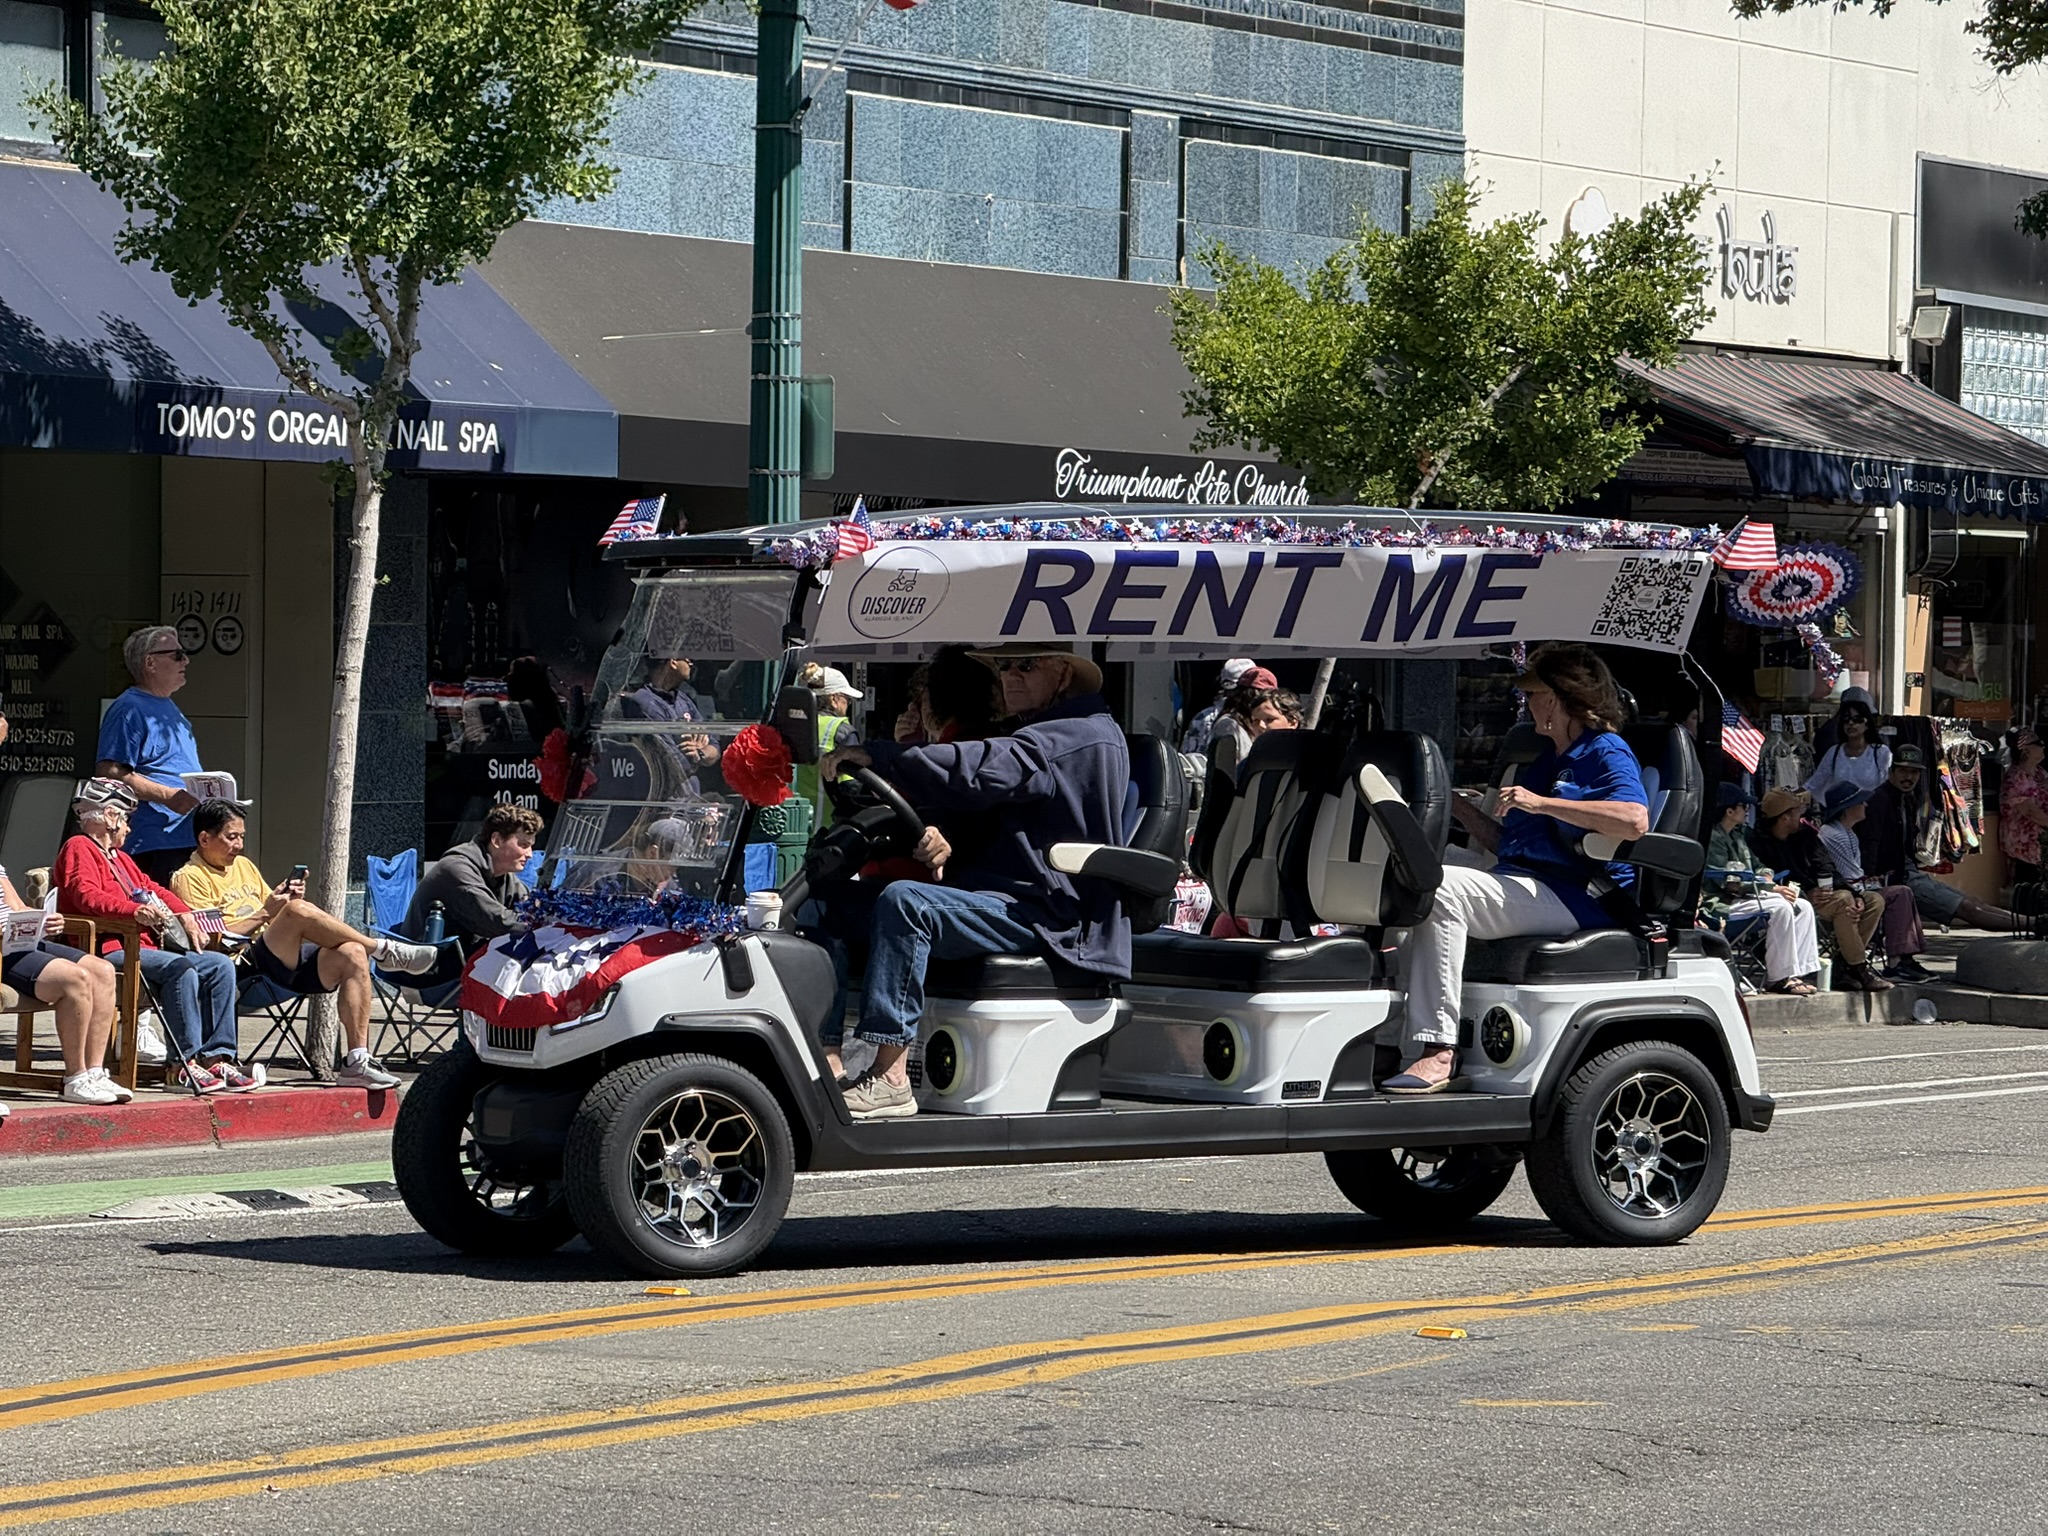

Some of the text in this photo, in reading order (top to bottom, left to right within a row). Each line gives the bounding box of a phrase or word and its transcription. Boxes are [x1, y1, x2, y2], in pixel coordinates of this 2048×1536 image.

[157, 403, 500, 454] TOMO'S ORGAI NAIL SPA
[1056, 448, 1310, 505] Triumphant Life Church
[1850, 461, 1891, 490] Global
[1891, 466, 1947, 496] Treasures
[1963, 475, 2005, 511] Unique
[171, 590, 241, 615] 1413 1411
[999, 548, 1544, 642] RENT ME
[861, 597, 926, 614] DISCOVER
[21, 624, 41, 640] NAIL
[46, 624, 63, 640] SPA
[5, 654, 39, 670] WAXING
[11, 679, 32, 695] NAIL
[4, 703, 45, 719] MASSAGE
[5, 728, 75, 746] 10-521-8778
[488, 758, 541, 784] Sunday
[611, 758, 635, 778] We
[493, 790, 538, 810] 10 am
